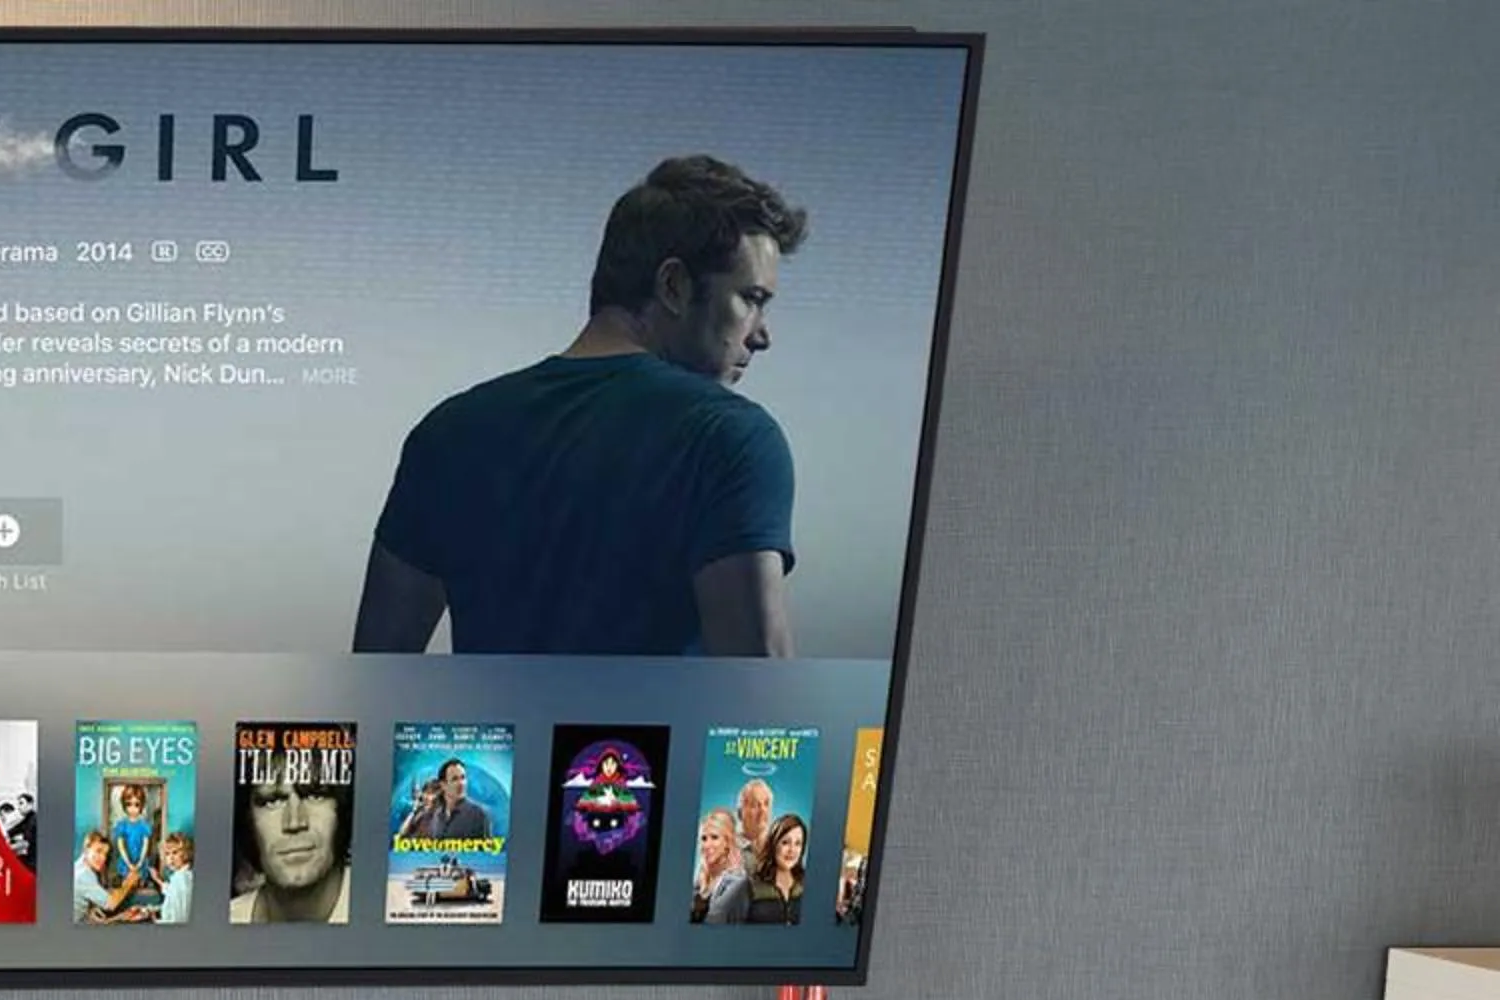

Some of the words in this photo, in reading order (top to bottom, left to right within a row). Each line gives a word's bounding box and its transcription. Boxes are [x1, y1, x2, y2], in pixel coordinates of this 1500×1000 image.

[54, 112, 338, 183] GIRL
[76, 242, 132, 262] 2014
[15, 303, 85, 323] based
[92, 309, 120, 323] on
[127, 303, 197, 323] Gillian
[203, 303, 285, 327] Flynn's
[32, 332, 113, 353] reveals
[119, 335, 203, 353] secrets
[208, 333, 232, 353] of
[236, 338, 249, 353] a
[256, 333, 344, 353] modern
[23, 362, 157, 388] anniversary,
[164, 363, 214, 384] Nick
[302, 368, 357, 384] MORE
[13, 572, 47, 590] List
[78, 736, 121, 766] BIG
[129, 736, 193, 766] EYES
[737, 736, 799, 761] VINCENT
[283, 748, 312, 785] BE
[319, 748, 353, 785] ME
[567, 879, 634, 899] KUMIKO
